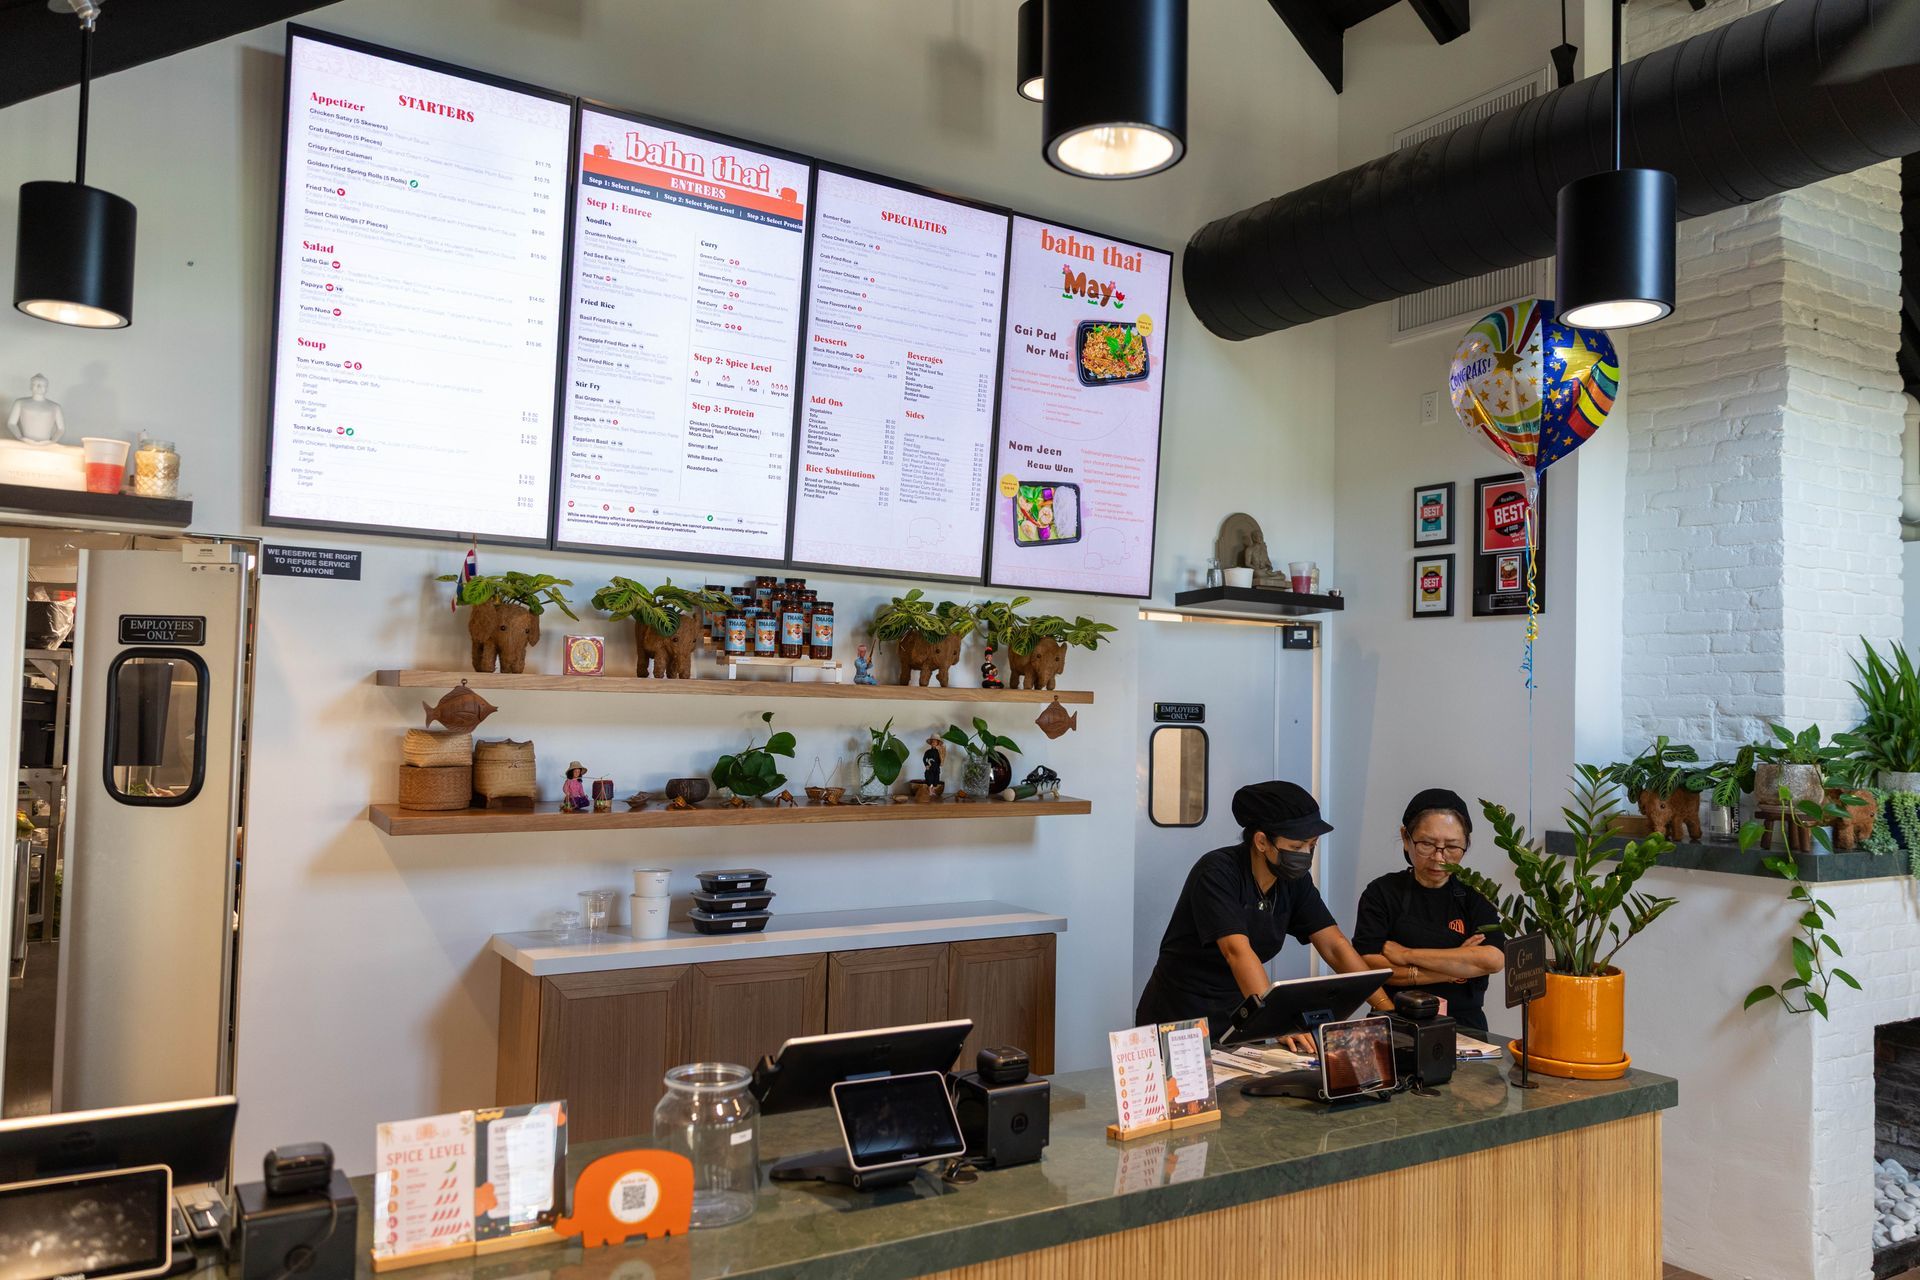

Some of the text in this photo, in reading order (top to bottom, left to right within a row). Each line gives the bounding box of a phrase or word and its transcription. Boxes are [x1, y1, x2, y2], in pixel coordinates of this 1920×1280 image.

[310, 92, 366, 112] Appetizer
[398, 94, 475, 122] STARTERS
[310, 108, 334, 118] Chicken
[336, 113, 352, 123] Satay
[361, 119, 388, 131] Skewers)
[308, 125, 324, 134] Crab
[325, 128, 352, 139] Rangoon
[361, 136, 382, 147] Pieces)
[308, 142, 373, 160] Crispy Fried Calamari
[626, 132, 770, 192] bahn thai
[307, 159, 329, 169] Golden
[330, 164, 346, 173] Fried
[347, 168, 366, 178] Spring
[368, 172, 383, 180] Rolls
[391, 176, 407, 185] Rolls)
[306, 184, 336, 195] Fried Tofu
[671, 177, 726, 199] ENTREES
[586, 197, 652, 219] Step 1: Entree
[589, 177, 602, 186] Step
[604, 180, 610, 188] 1:
[611, 181, 630, 192] Select
[631, 185, 650, 196] Entree
[664, 193, 678, 204] Step
[679, 196, 684, 204] 2:
[684, 198, 702, 209] Select
[703, 201, 719, 212] Spice
[720, 204, 735, 215] Level
[747, 212, 760, 222] Step
[766, 216, 782, 227] Select
[784, 220, 803, 231] Protein
[304, 208, 323, 218] Sweet
[324, 212, 339, 221] Chili
[339, 215, 358, 225] Wings
[366, 220, 388, 230] Pieces)
[585, 216, 612, 227] Noodles
[881, 210, 948, 236] SPECIALTIES
[584, 230, 625, 242] Drunken Noodle
[303, 240, 334, 254] Salad
[700, 240, 718, 250] Curry
[1041, 228, 1142, 273] bahn thai
[592, 273, 604, 281] Thai
[301, 280, 323, 290] Papaya
[1064, 271, 1115, 307] May
[580, 298, 616, 310] Fried Rice
[1014, 324, 1056, 340] Gai Pad
[297, 336, 326, 351] Soup
[578, 336, 603, 344] Pineapple
[814, 334, 848, 347] Desserts
[907, 351, 944, 365] Beverages
[1026, 344, 1069, 360] Nor Mai
[694, 353, 772, 373] Step 2: Spice Level
[1450, 358, 1491, 391] CONGRATS!
[575, 380, 600, 391] Stir Fry
[810, 395, 843, 407] Add Ons
[692, 402, 755, 419] Step 3: Protein
[905, 410, 925, 420] Sides
[574, 415, 596, 423] Bangkok
[316, 427, 332, 435] Soup
[1008, 440, 1062, 456] Nom Jeen
[806, 464, 876, 480] Rice Substitutions
[1027, 460, 1073, 473] Keaw Wan
[1424, 506, 1440, 517] BEST
[1494, 502, 1525, 525] BEST
[282, 550, 317, 558] RESERVE
[335, 553, 358, 561] RIGHT
[287, 558, 317, 566] REFUSE
[318, 560, 351, 568] SERVICE
[303, 567, 334, 575] ANYONE
[1423, 578, 1440, 587] BEST
[130, 620, 194, 630] EMPLOYEES
[147, 630, 176, 640] ONLY
[1116, 1048, 1156, 1064] SPICE LEVEL
[386, 1144, 466, 1166] SPICE LEVEL
